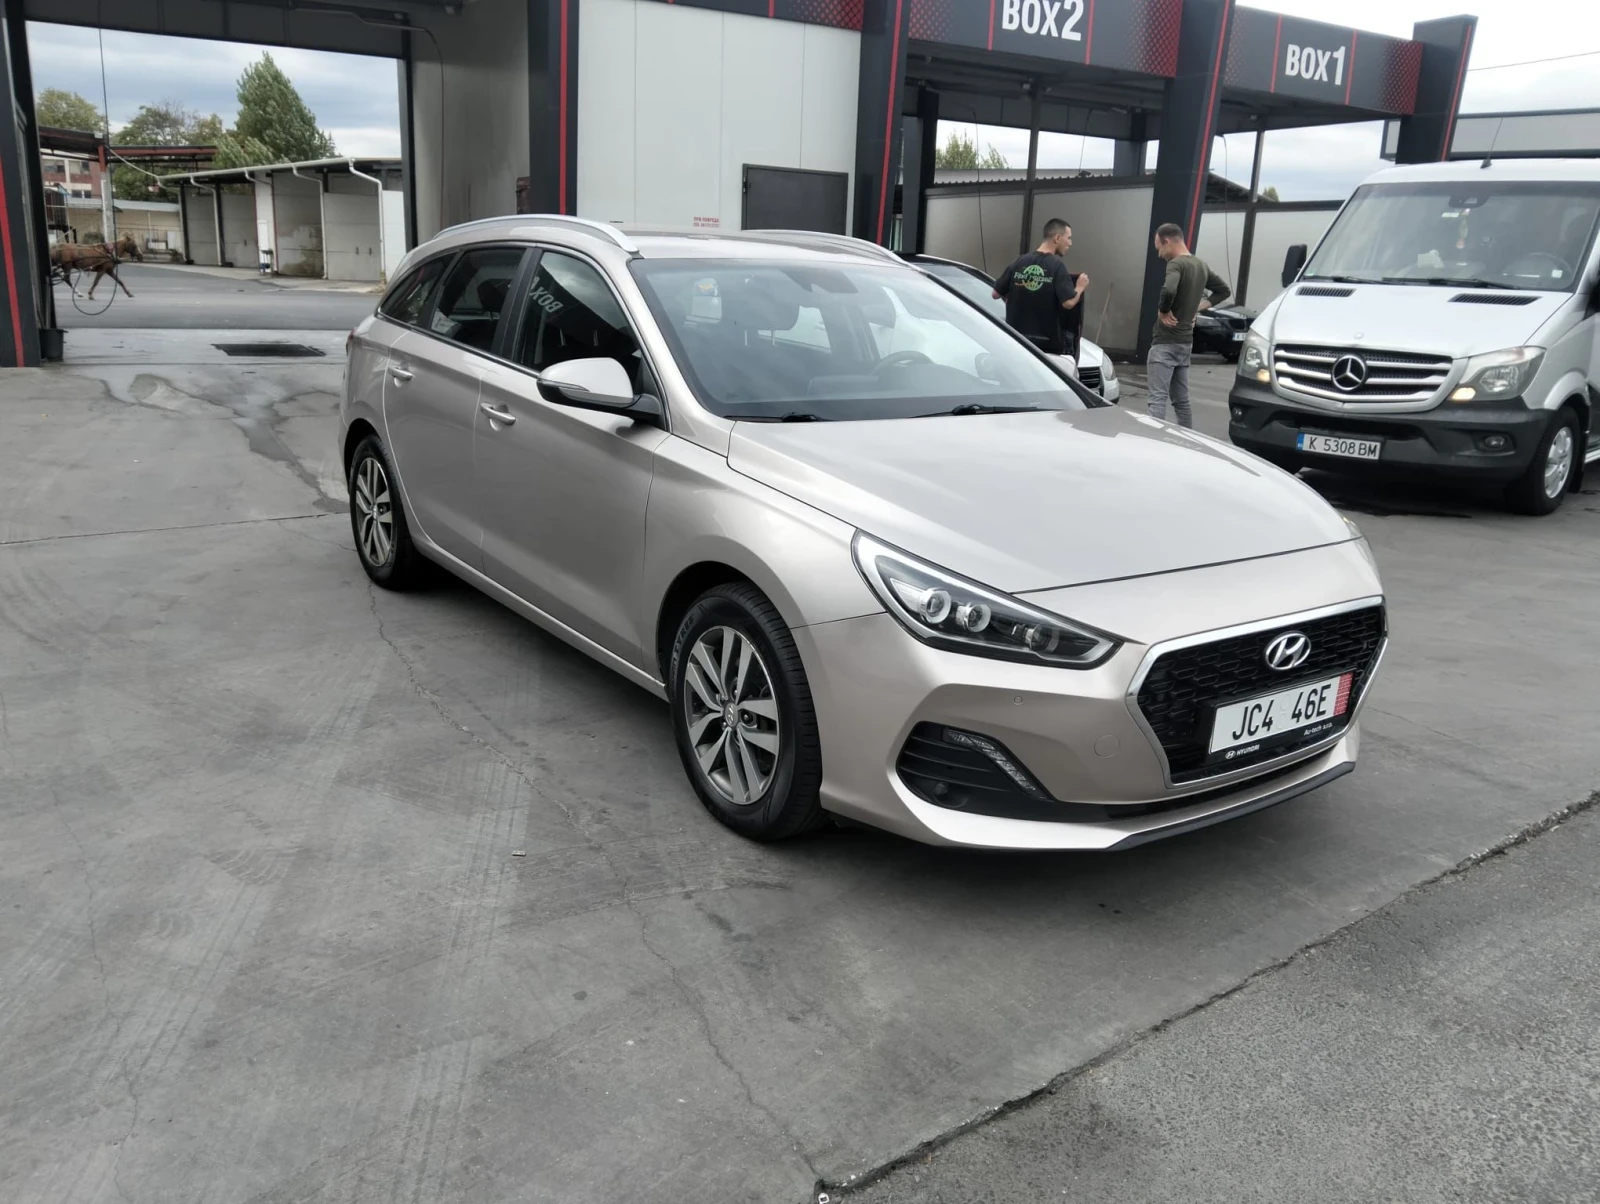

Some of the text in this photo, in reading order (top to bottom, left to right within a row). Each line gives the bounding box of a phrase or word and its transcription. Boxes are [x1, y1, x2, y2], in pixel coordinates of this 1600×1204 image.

[1002, 0, 1084, 41] BOX2
[1285, 44, 1346, 86] BOX1
[1309, 436, 1378, 458] K 5308 BM
[1232, 699, 1275, 741] JC4
[1291, 683, 1332, 723] 46E
